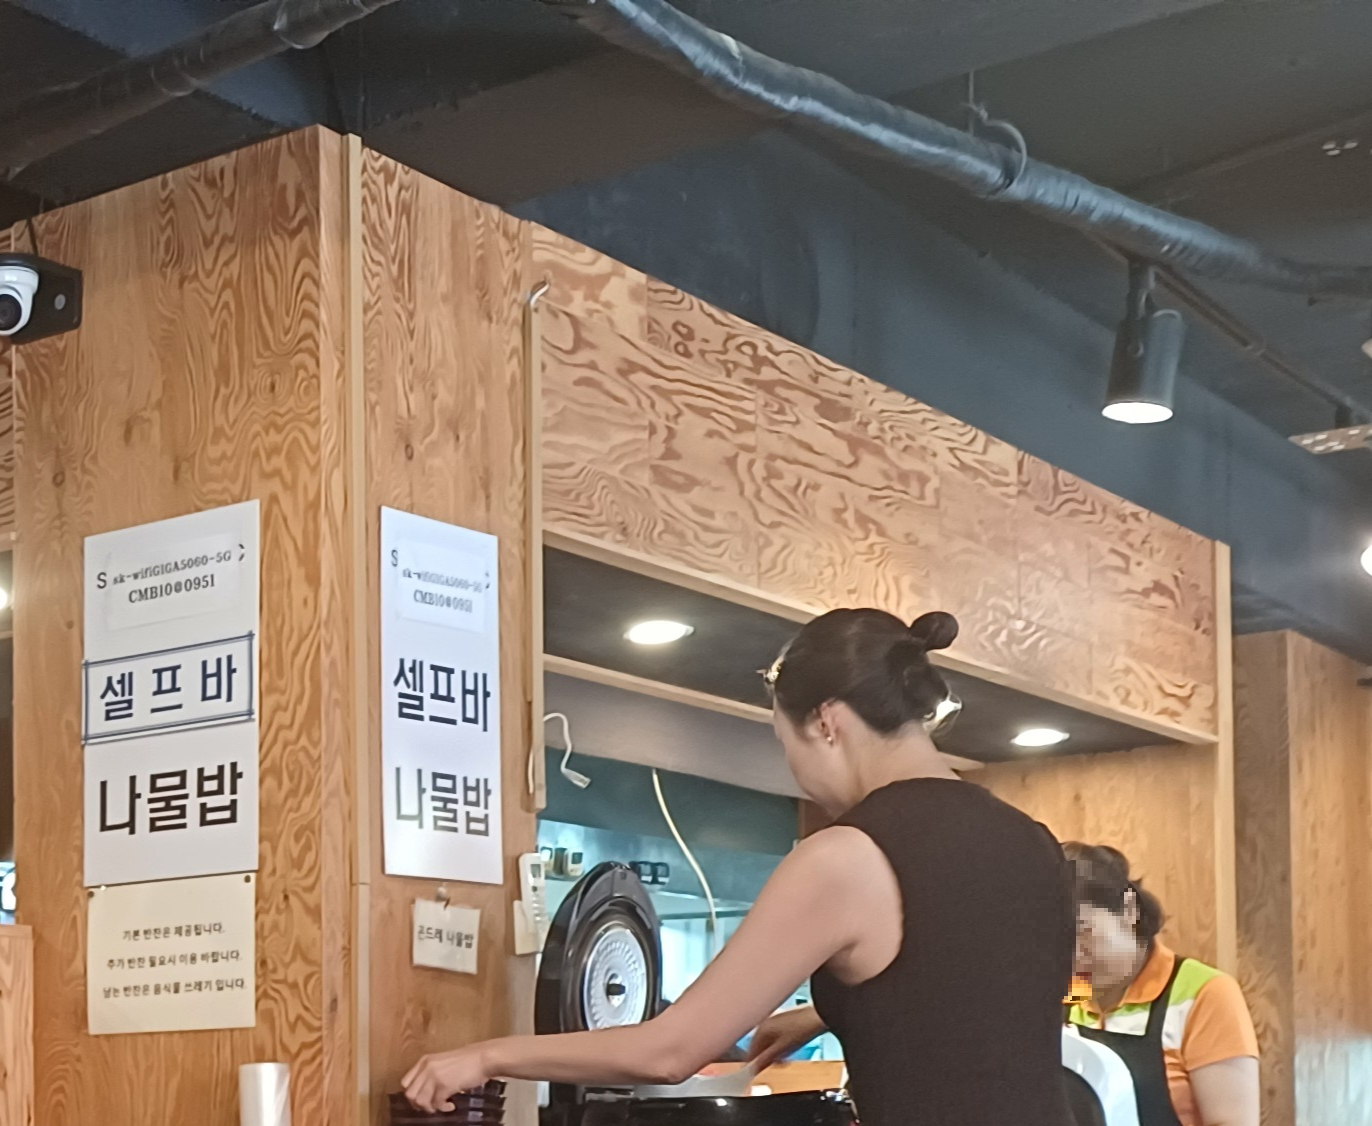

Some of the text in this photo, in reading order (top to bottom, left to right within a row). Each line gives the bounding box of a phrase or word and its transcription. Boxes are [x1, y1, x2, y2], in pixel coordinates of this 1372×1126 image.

[393, 657, 491, 732] 셀프바
[98, 761, 244, 836] 나물밥
[394, 766, 492, 837] 나물밥
[122, 929, 140, 942] 기본
[143, 926, 171, 940] 반찬은
[127, 956, 146, 969] 반찬
